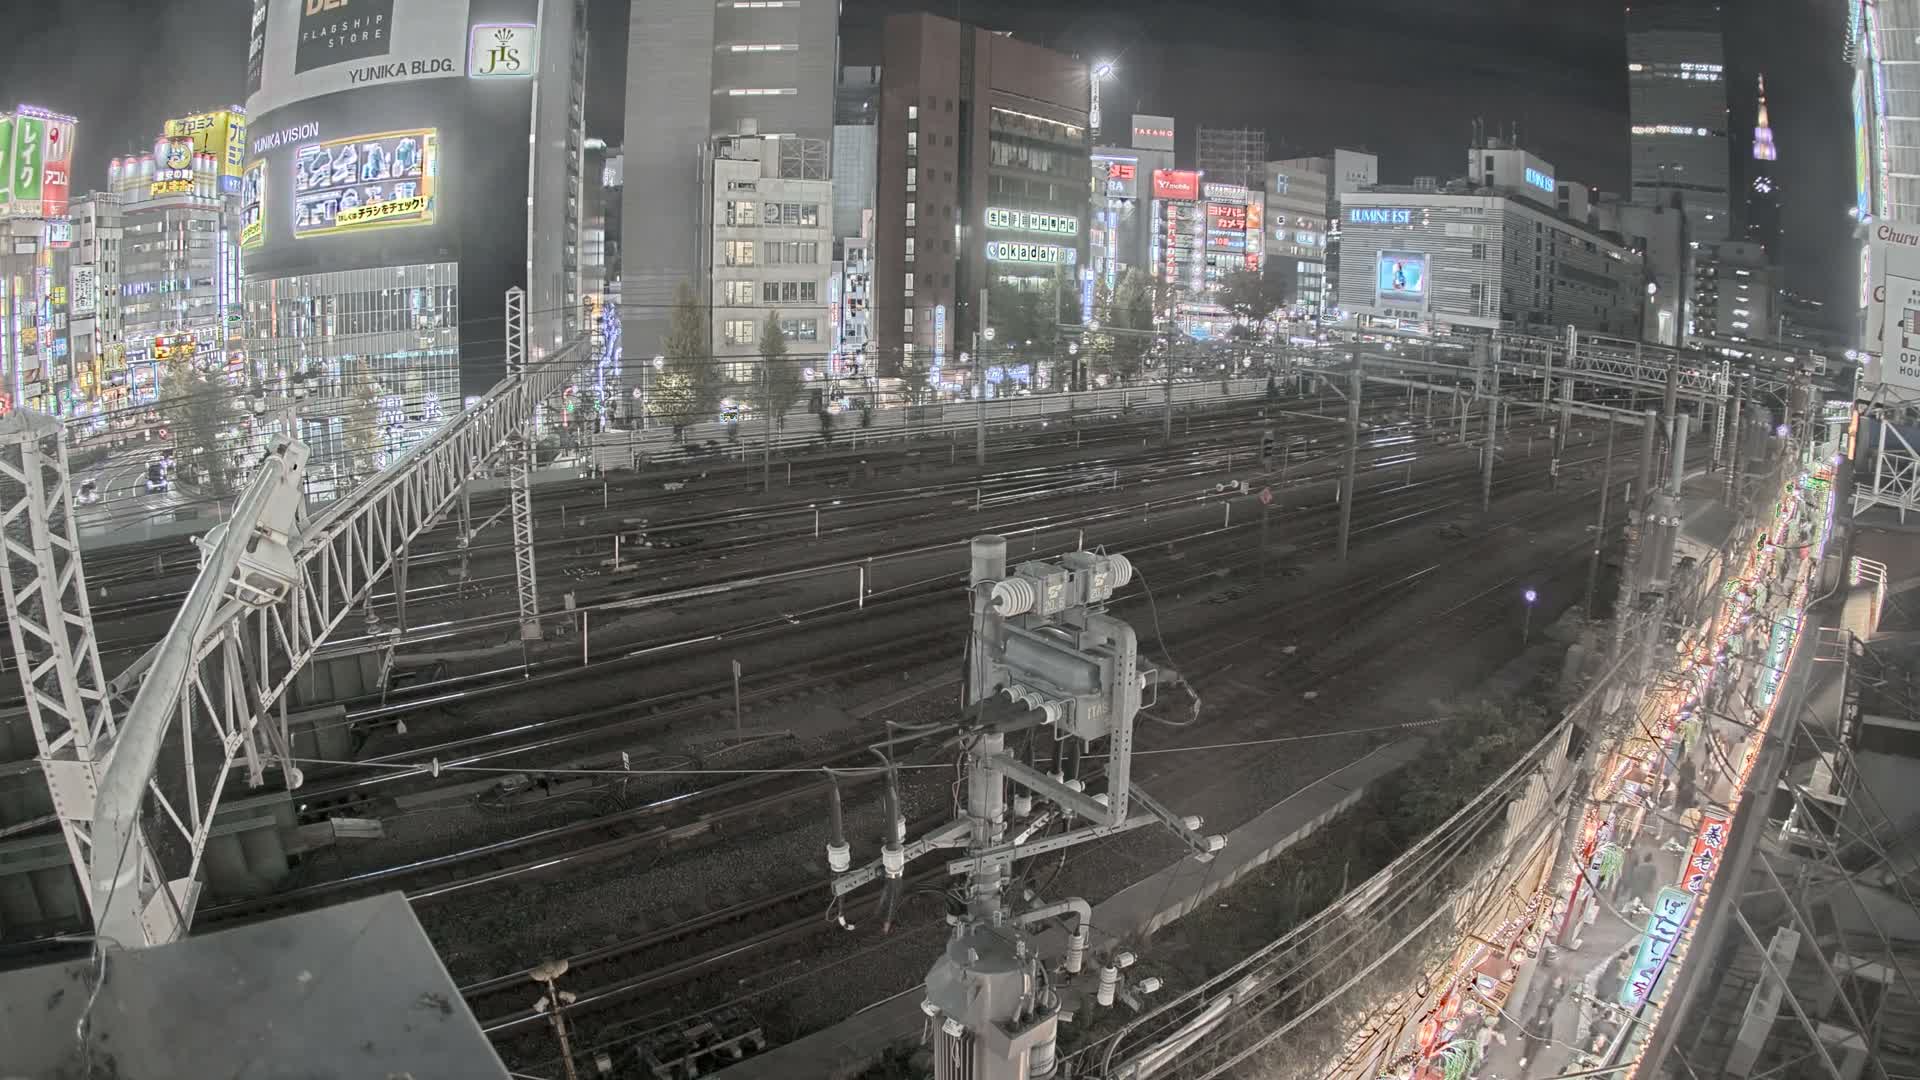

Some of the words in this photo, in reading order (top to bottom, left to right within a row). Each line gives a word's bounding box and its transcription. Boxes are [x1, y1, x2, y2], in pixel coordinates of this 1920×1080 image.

[303, 15, 383, 41] FLAGSHIP
[328, 29, 382, 48] STORE
[349, 63, 408, 84] YUNIKA
[411, 58, 456, 75] BLDG.
[254, 131, 281, 154] YUNIKA
[282, 121, 320, 145] VISION
[1134, 127, 1174, 137] TAKANO
[20, 121, 37, 189] レイク
[44, 169, 68, 186] アコム
[1208, 206, 1246, 217] ヨドバシ
[1352, 209, 1388, 223] LUMINE
[1391, 209, 1411, 223] EST
[1218, 219, 1246, 229] カメラ
[1877, 225, 1919, 247] Churu
[1000, 247, 1065, 262] okadaya
[1900, 352, 1920, 366] OP
